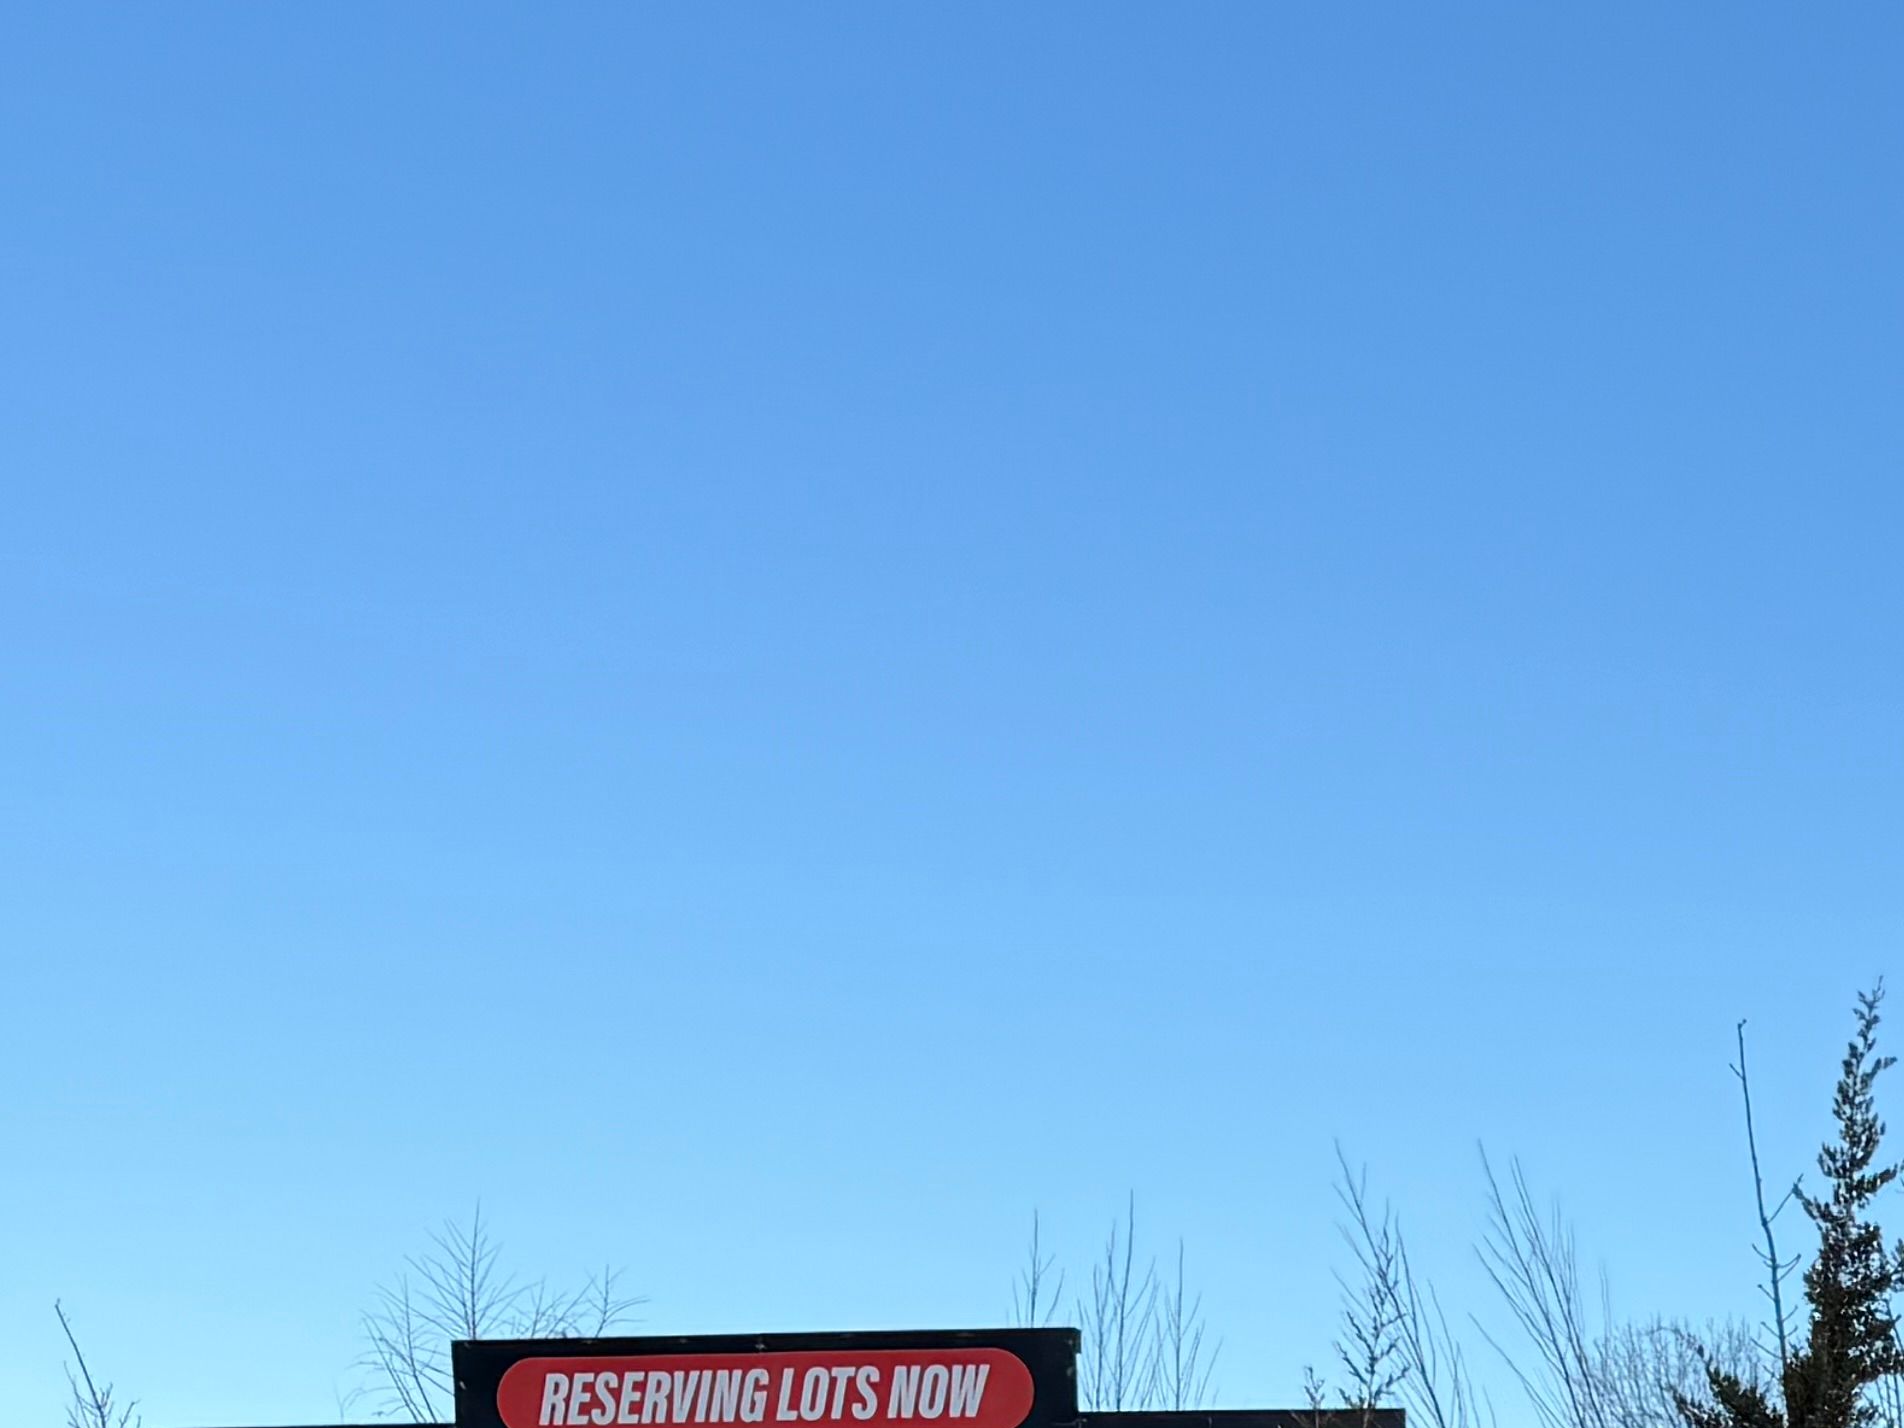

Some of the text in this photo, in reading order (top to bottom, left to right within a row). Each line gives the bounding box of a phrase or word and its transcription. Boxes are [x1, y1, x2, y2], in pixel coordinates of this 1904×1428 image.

[539, 1364, 990, 1426] RESERVING LOTS NOW
